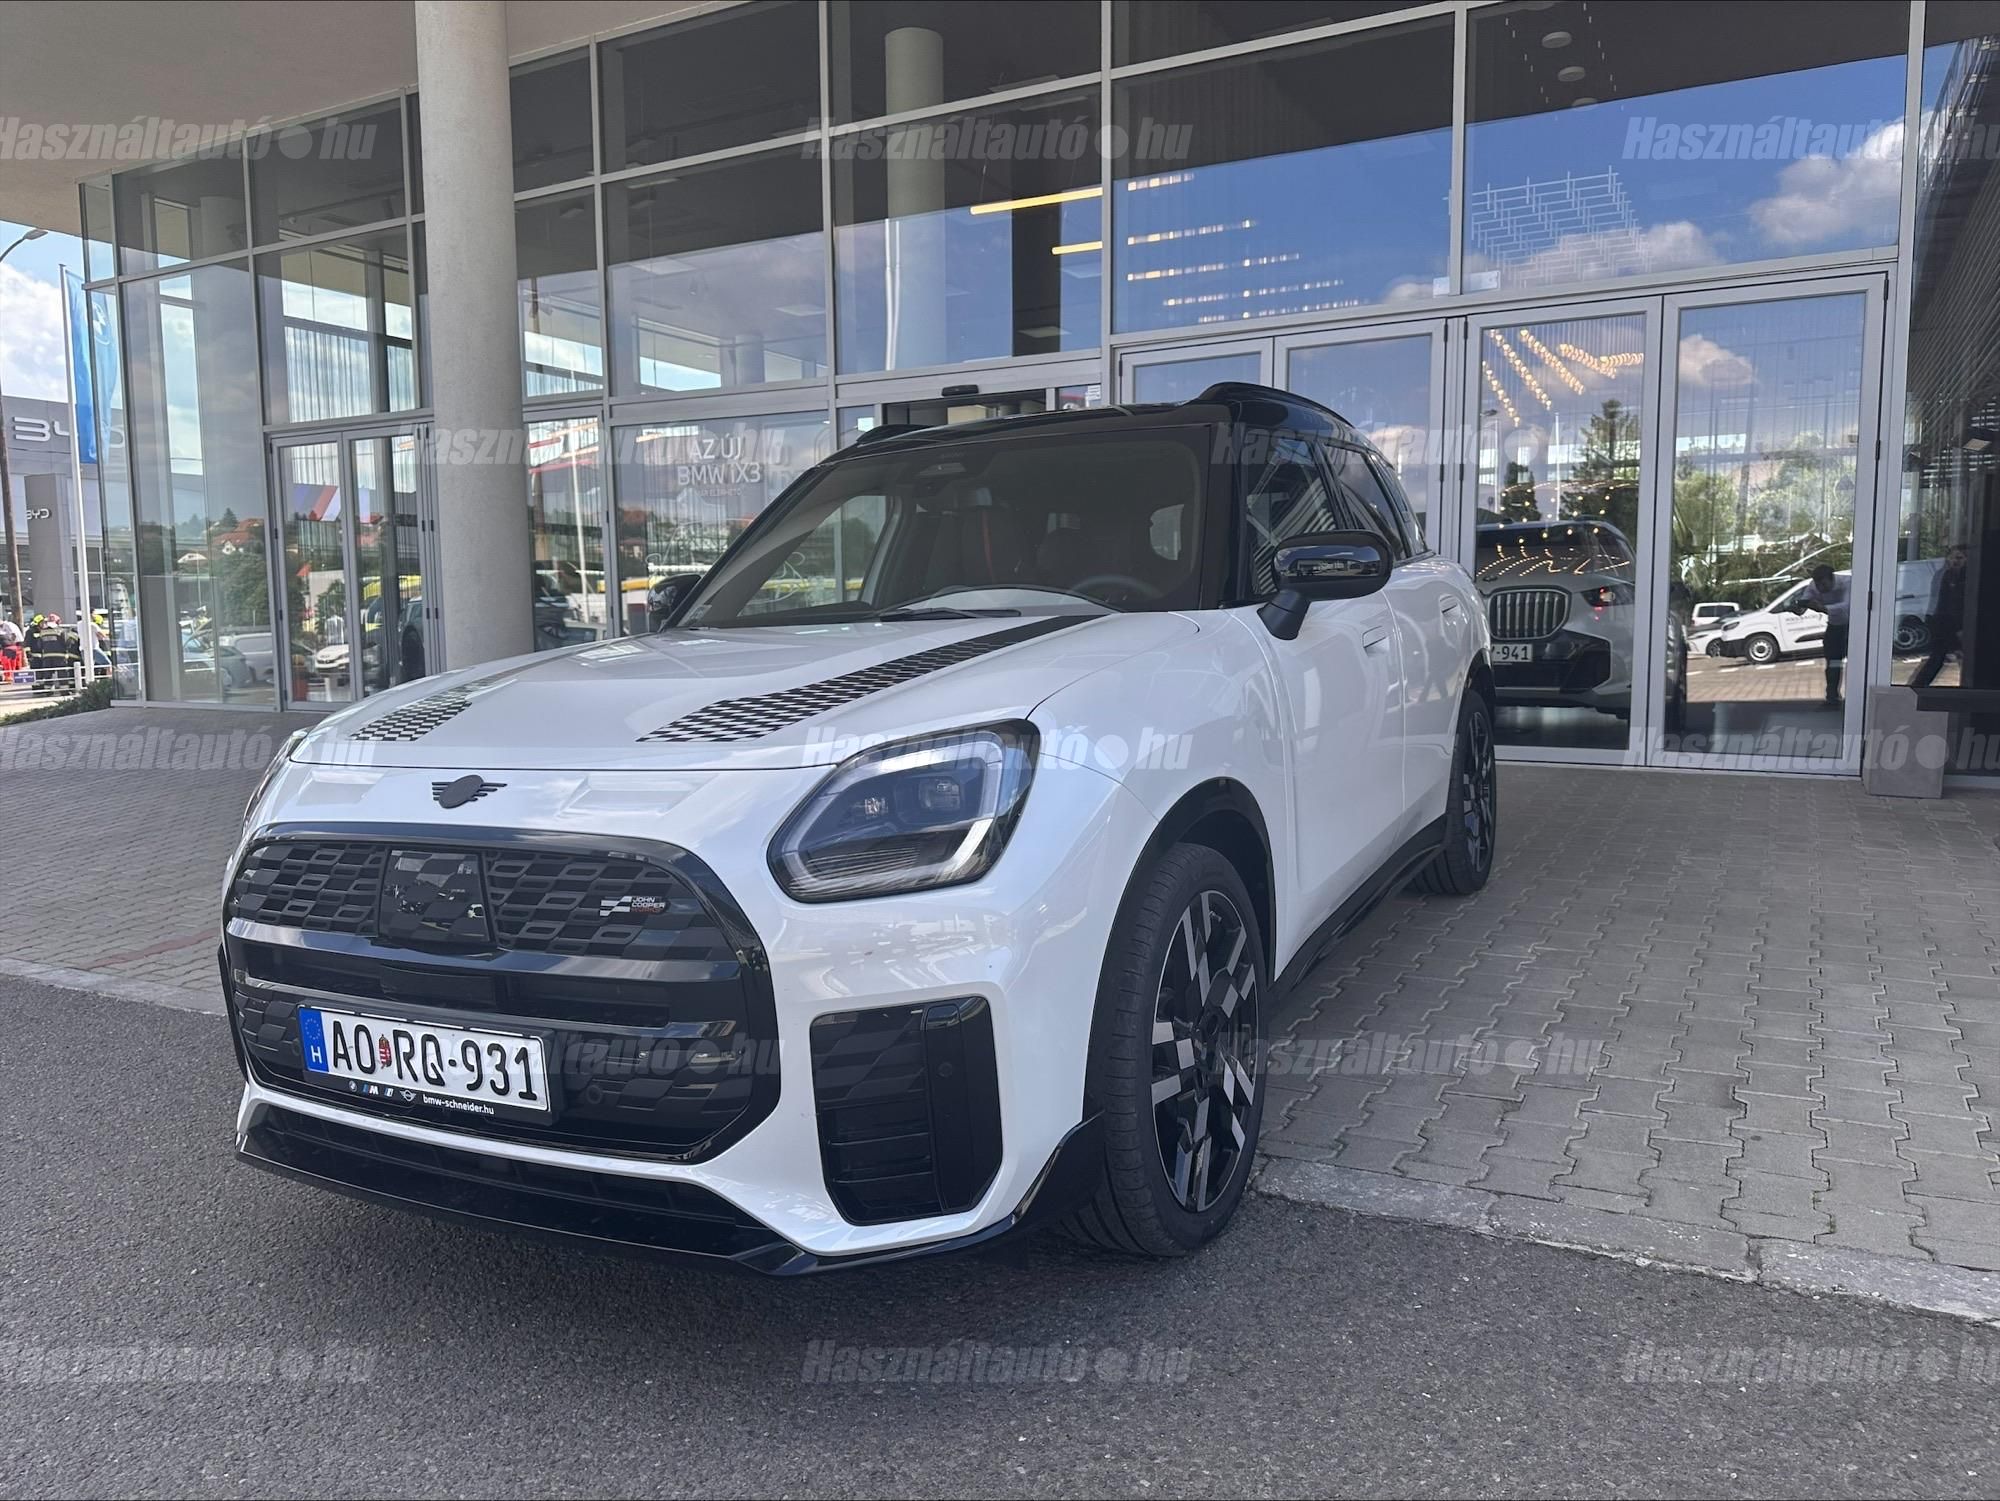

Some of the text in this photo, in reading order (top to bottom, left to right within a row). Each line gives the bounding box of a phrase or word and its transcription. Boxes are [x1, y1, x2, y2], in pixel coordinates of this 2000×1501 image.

[690, 433, 741, 460] AZ ÚJ
[677, 463, 725, 486] BMW
[311, 1045, 323, 1064] H
[423, 1094, 495, 1115] bmw-schneider.hu
